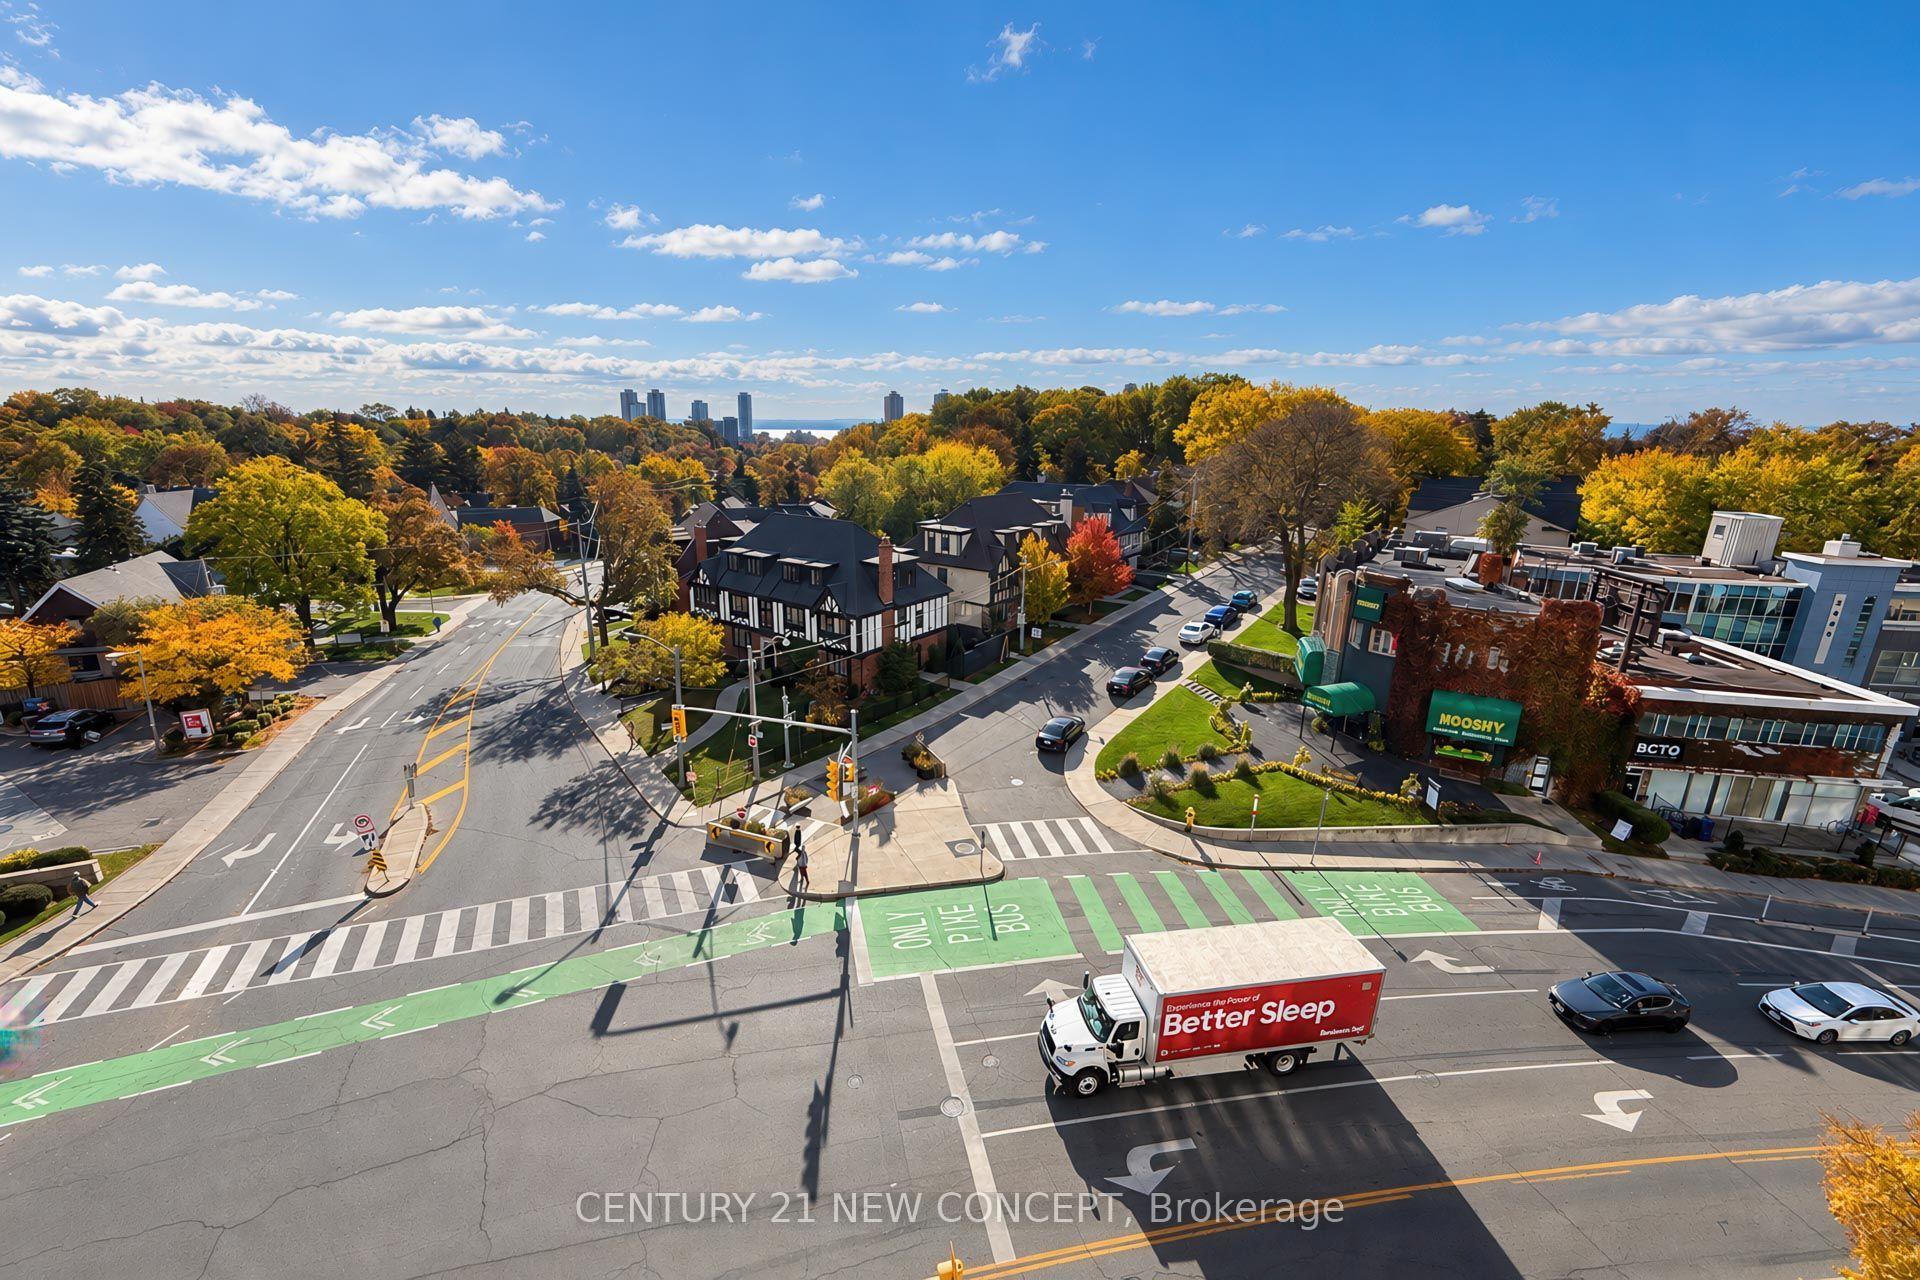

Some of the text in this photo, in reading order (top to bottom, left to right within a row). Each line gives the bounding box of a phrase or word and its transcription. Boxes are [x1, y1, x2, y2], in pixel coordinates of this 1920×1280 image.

[1438, 712, 1505, 735] MOOSHY
[1636, 742, 1681, 757] BCTO
[885, 911, 932, 950] ONLY
[983, 903, 1031, 934] BUS
[1162, 999, 1336, 1037] Better Sleep
